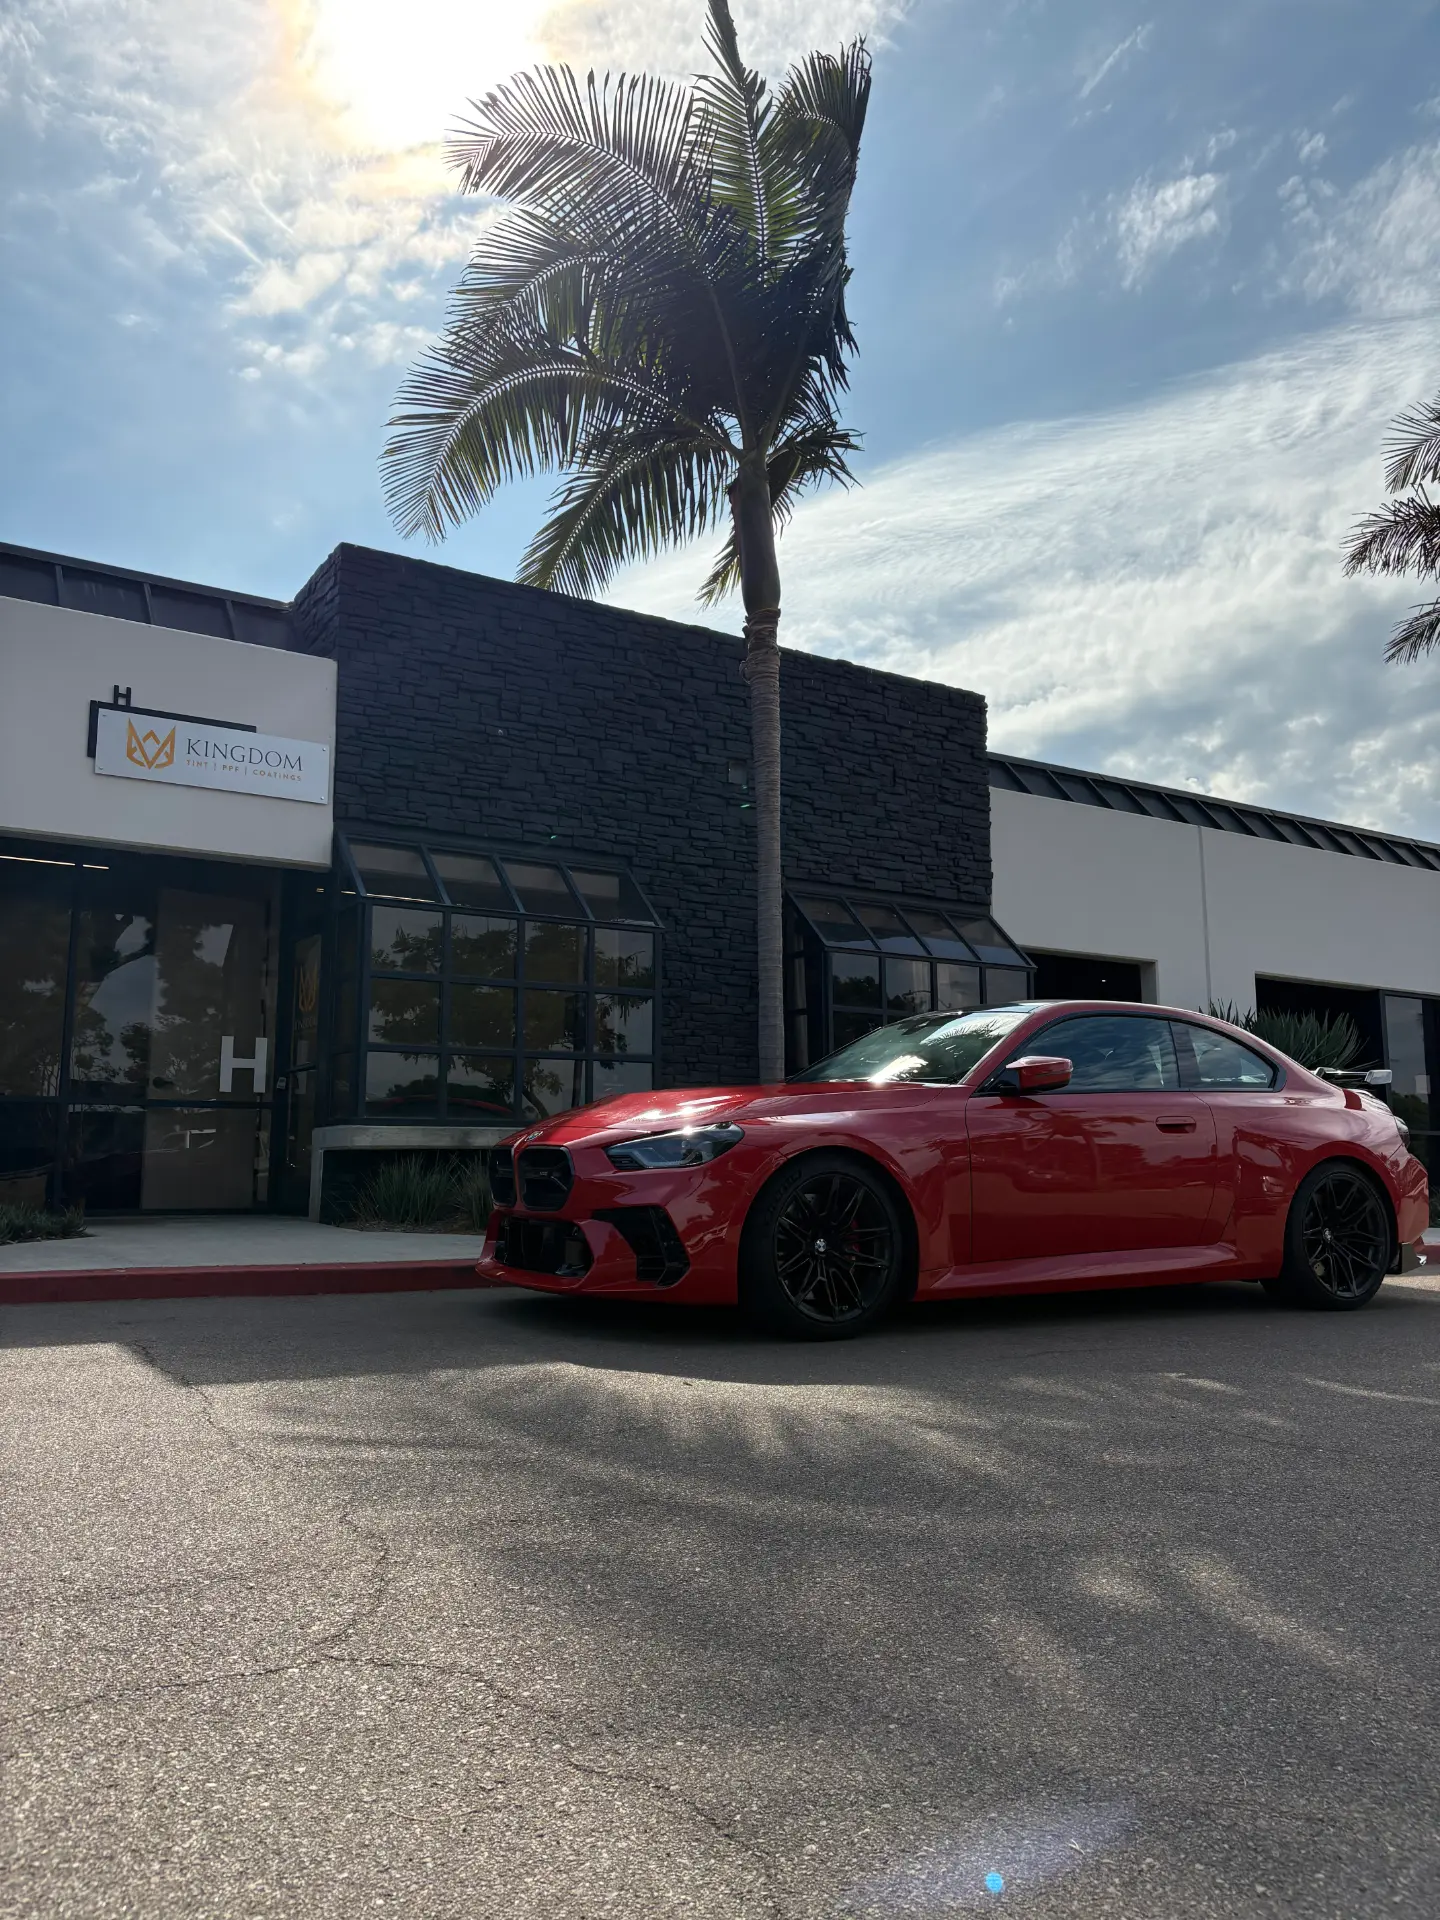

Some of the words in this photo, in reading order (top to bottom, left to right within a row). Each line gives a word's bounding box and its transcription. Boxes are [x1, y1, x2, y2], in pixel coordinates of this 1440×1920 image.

[186, 738, 303, 772] KINGDOM
[186, 759, 209, 770] TINT
[222, 764, 240, 773] PPF
[253, 769, 302, 782] COATINGS
[219, 1035, 268, 1093] H
